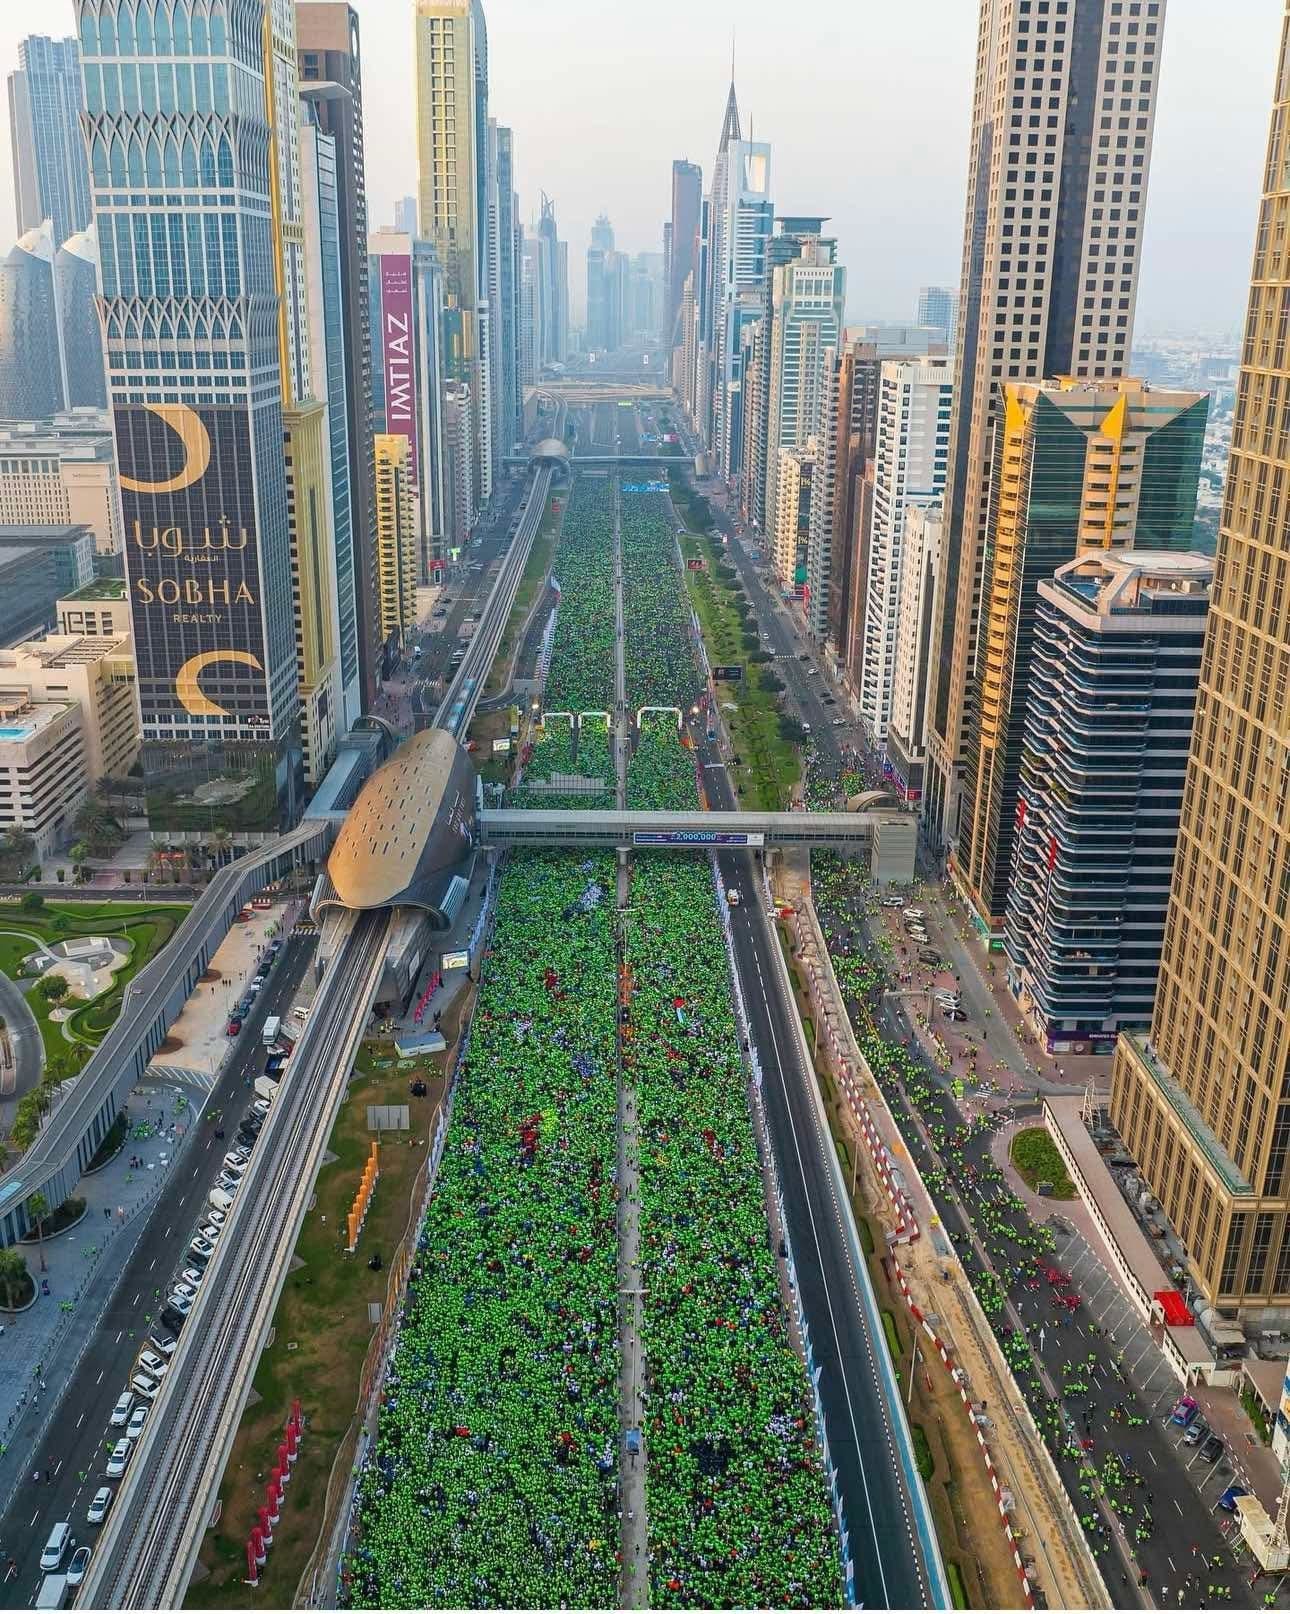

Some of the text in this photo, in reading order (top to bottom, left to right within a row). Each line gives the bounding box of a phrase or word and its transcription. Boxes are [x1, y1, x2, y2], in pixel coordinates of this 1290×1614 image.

[387, 312, 411, 420] IMTIAZ
[137, 578, 255, 604] SOBHA
[173, 614, 223, 624] REALTY
